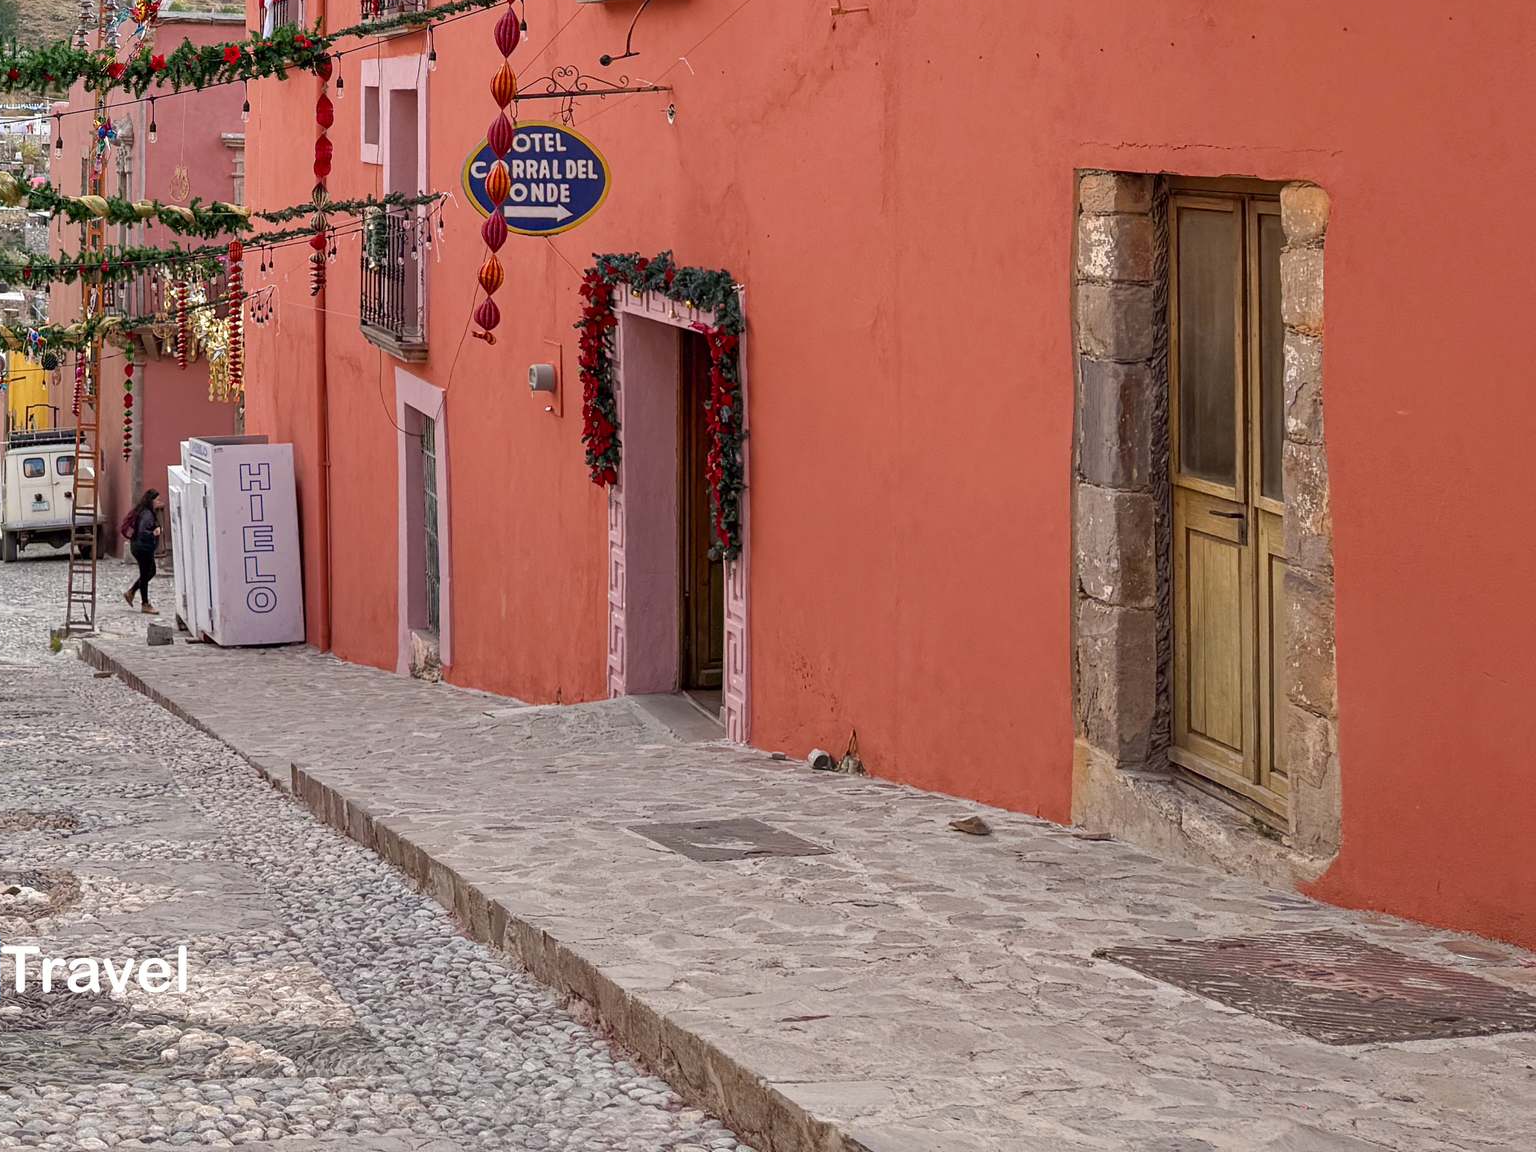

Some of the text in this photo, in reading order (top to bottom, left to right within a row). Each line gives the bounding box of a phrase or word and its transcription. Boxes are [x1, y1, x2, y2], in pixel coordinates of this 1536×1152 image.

[507, 132, 567, 153] OTEL
[565, 159, 599, 180] DEL
[509, 182, 570, 203] ONDE
[239, 463, 277, 613] HIELO
